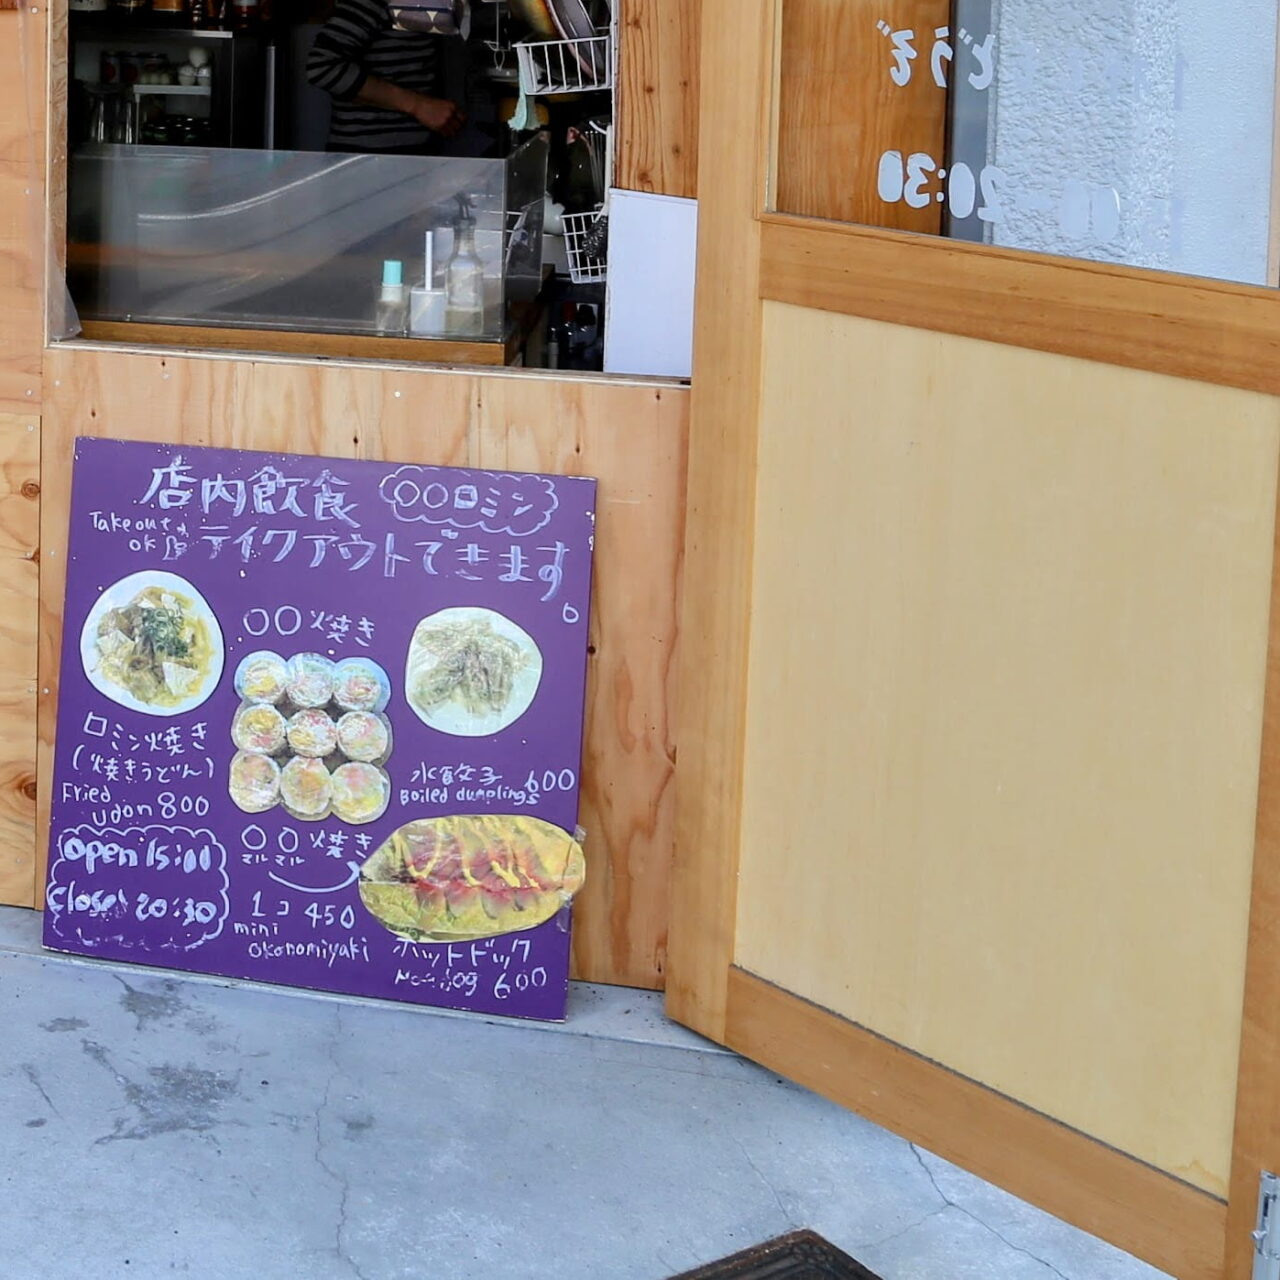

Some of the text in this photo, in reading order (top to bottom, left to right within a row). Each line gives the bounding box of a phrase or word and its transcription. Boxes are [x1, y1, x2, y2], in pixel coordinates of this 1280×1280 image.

[139, 458, 361, 528] 店内飲食
[83, 711, 208, 755] ロミン焼き
[62, 782, 112, 804] Fried
[410, 761, 577, 794] 水餃子 600
[157, 791, 210, 820] 800
[399, 787, 449, 807] Boiled
[146, 837, 212, 875] 15:00
[233, 922, 280, 937] mini
[304, 902, 356, 930] 450
[493, 967, 548, 1000] 600
